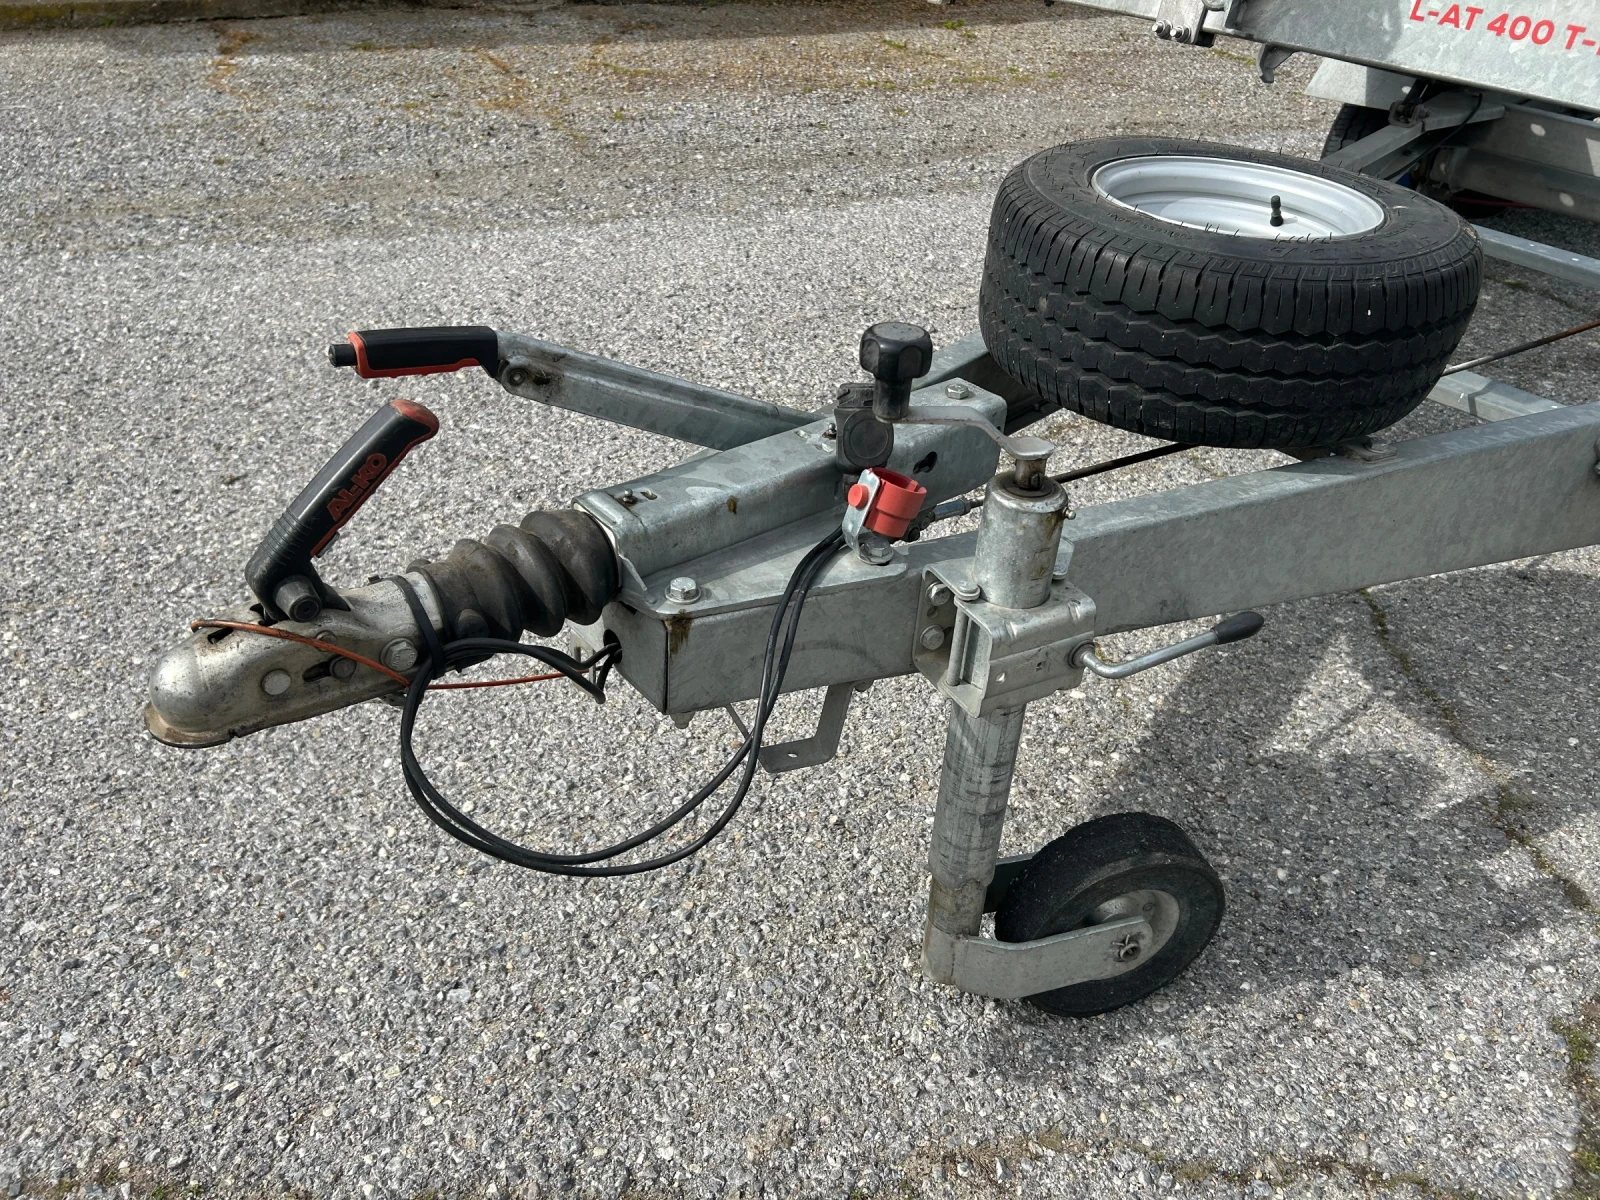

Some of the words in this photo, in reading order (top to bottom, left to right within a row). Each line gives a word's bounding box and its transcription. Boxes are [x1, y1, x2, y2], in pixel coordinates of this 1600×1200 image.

[1409, 0, 1484, 31] L-AT
[1487, 13, 1555, 45] 400
[1565, 24, 1600, 56] T-
[327, 453, 387, 521] AL-KO
